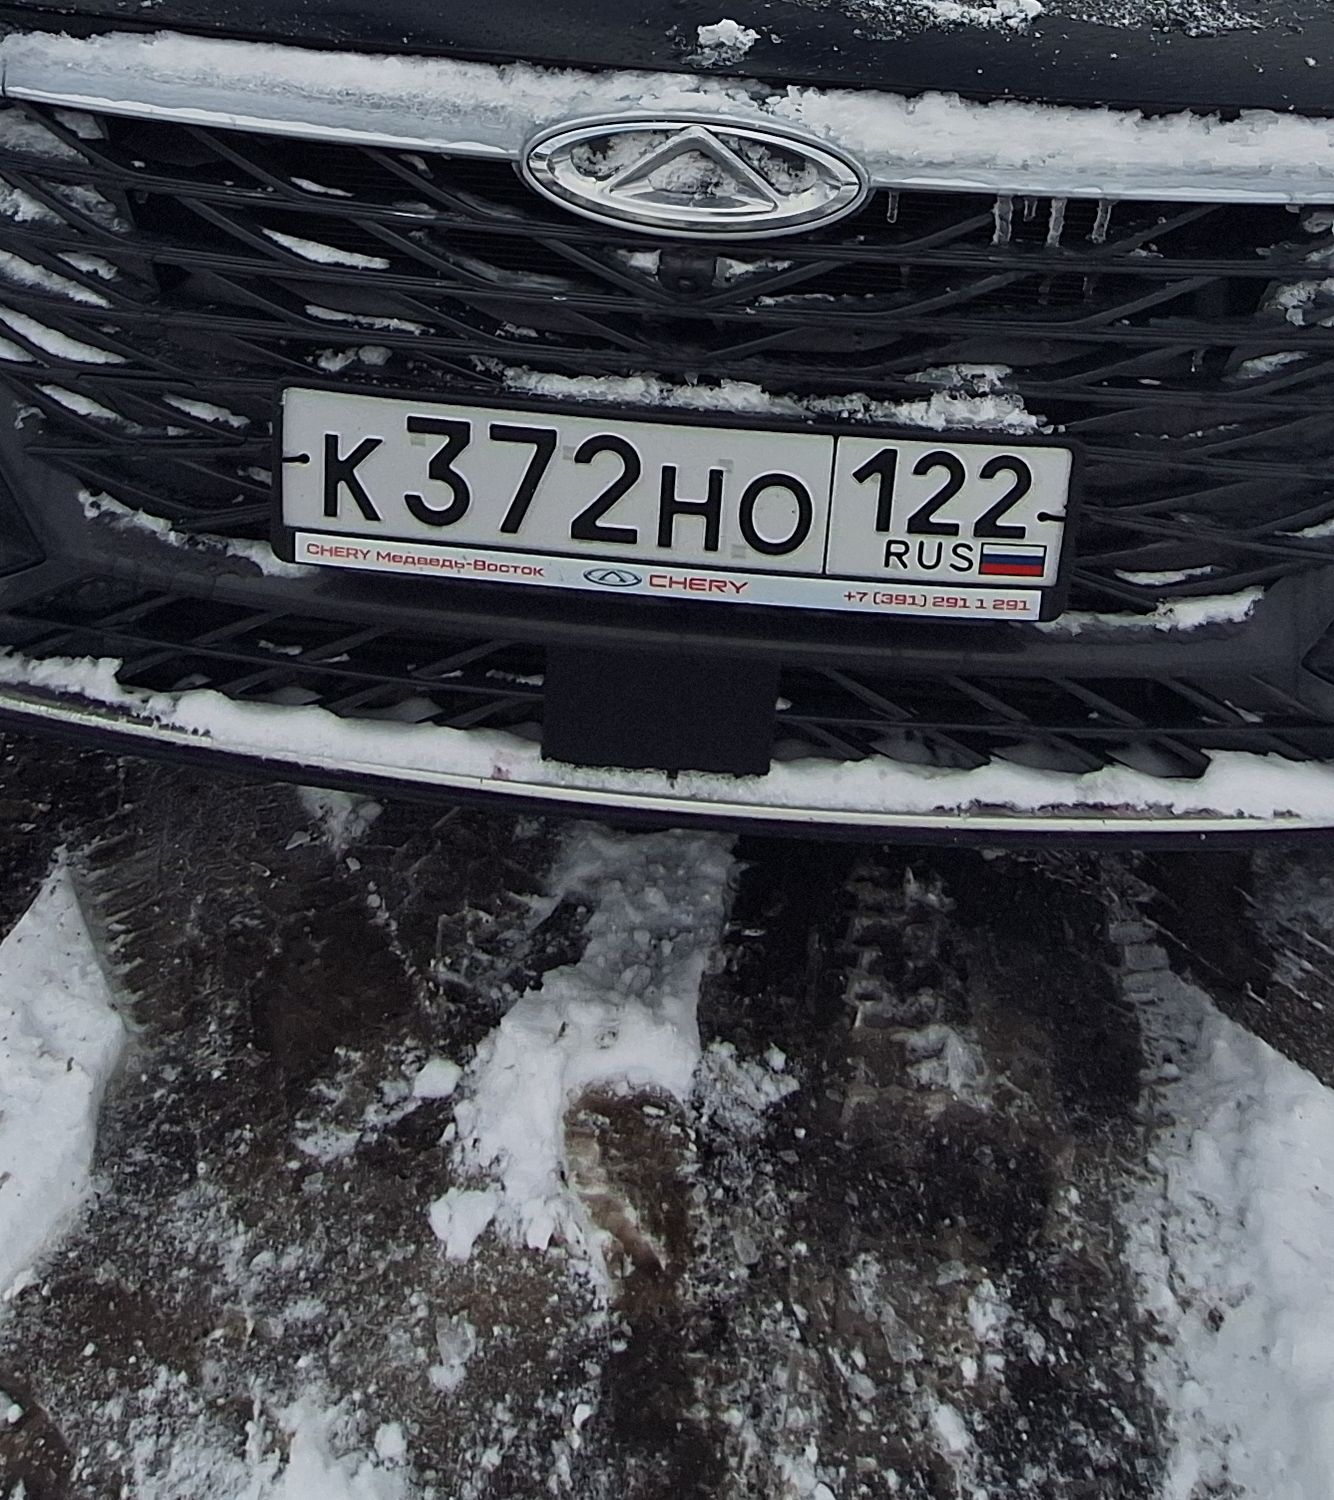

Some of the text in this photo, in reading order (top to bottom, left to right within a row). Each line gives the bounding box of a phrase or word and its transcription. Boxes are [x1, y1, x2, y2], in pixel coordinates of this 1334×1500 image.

[321, 415, 814, 557] К372НО
[851, 447, 1033, 540] 122
[306, 542, 545, 577] CHERY Медведь-Восток
[883, 539, 974, 572] RUS
[648, 574, 749, 594] CHERY
[843, 591, 1031, 611] +7 (391) 291 1 291
